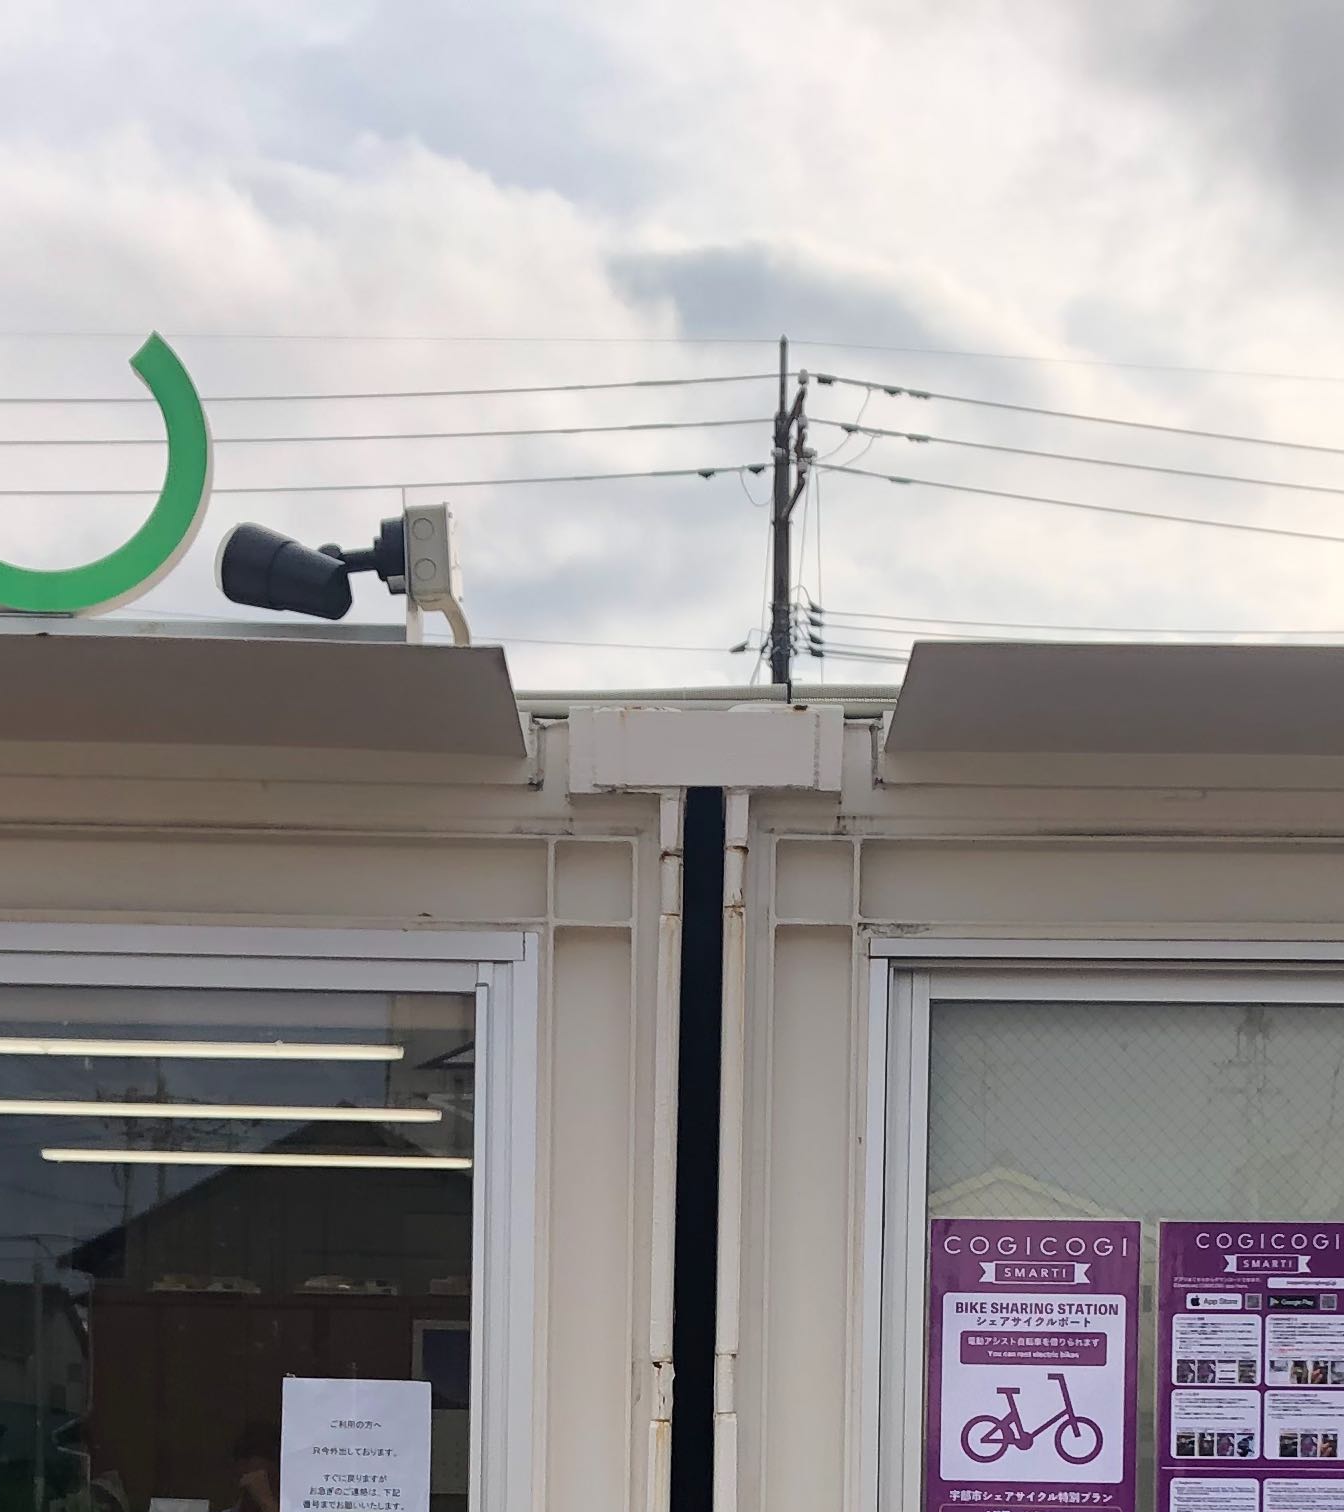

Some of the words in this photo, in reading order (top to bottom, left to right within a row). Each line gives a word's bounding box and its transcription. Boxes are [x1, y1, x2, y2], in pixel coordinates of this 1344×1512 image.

[943, 1236, 1129, 1257] COGICOGI
[1196, 1233, 1340, 1250] COGICOGI
[955, 1302, 987, 1314] BIKE
[990, 1302, 1054, 1315] SHARING
[1057, 1303, 1119, 1316] STATION
[976, 1316, 1092, 1328] シェアサイクルポート
[330, 1420, 382, 1430] ご利用の方へ
